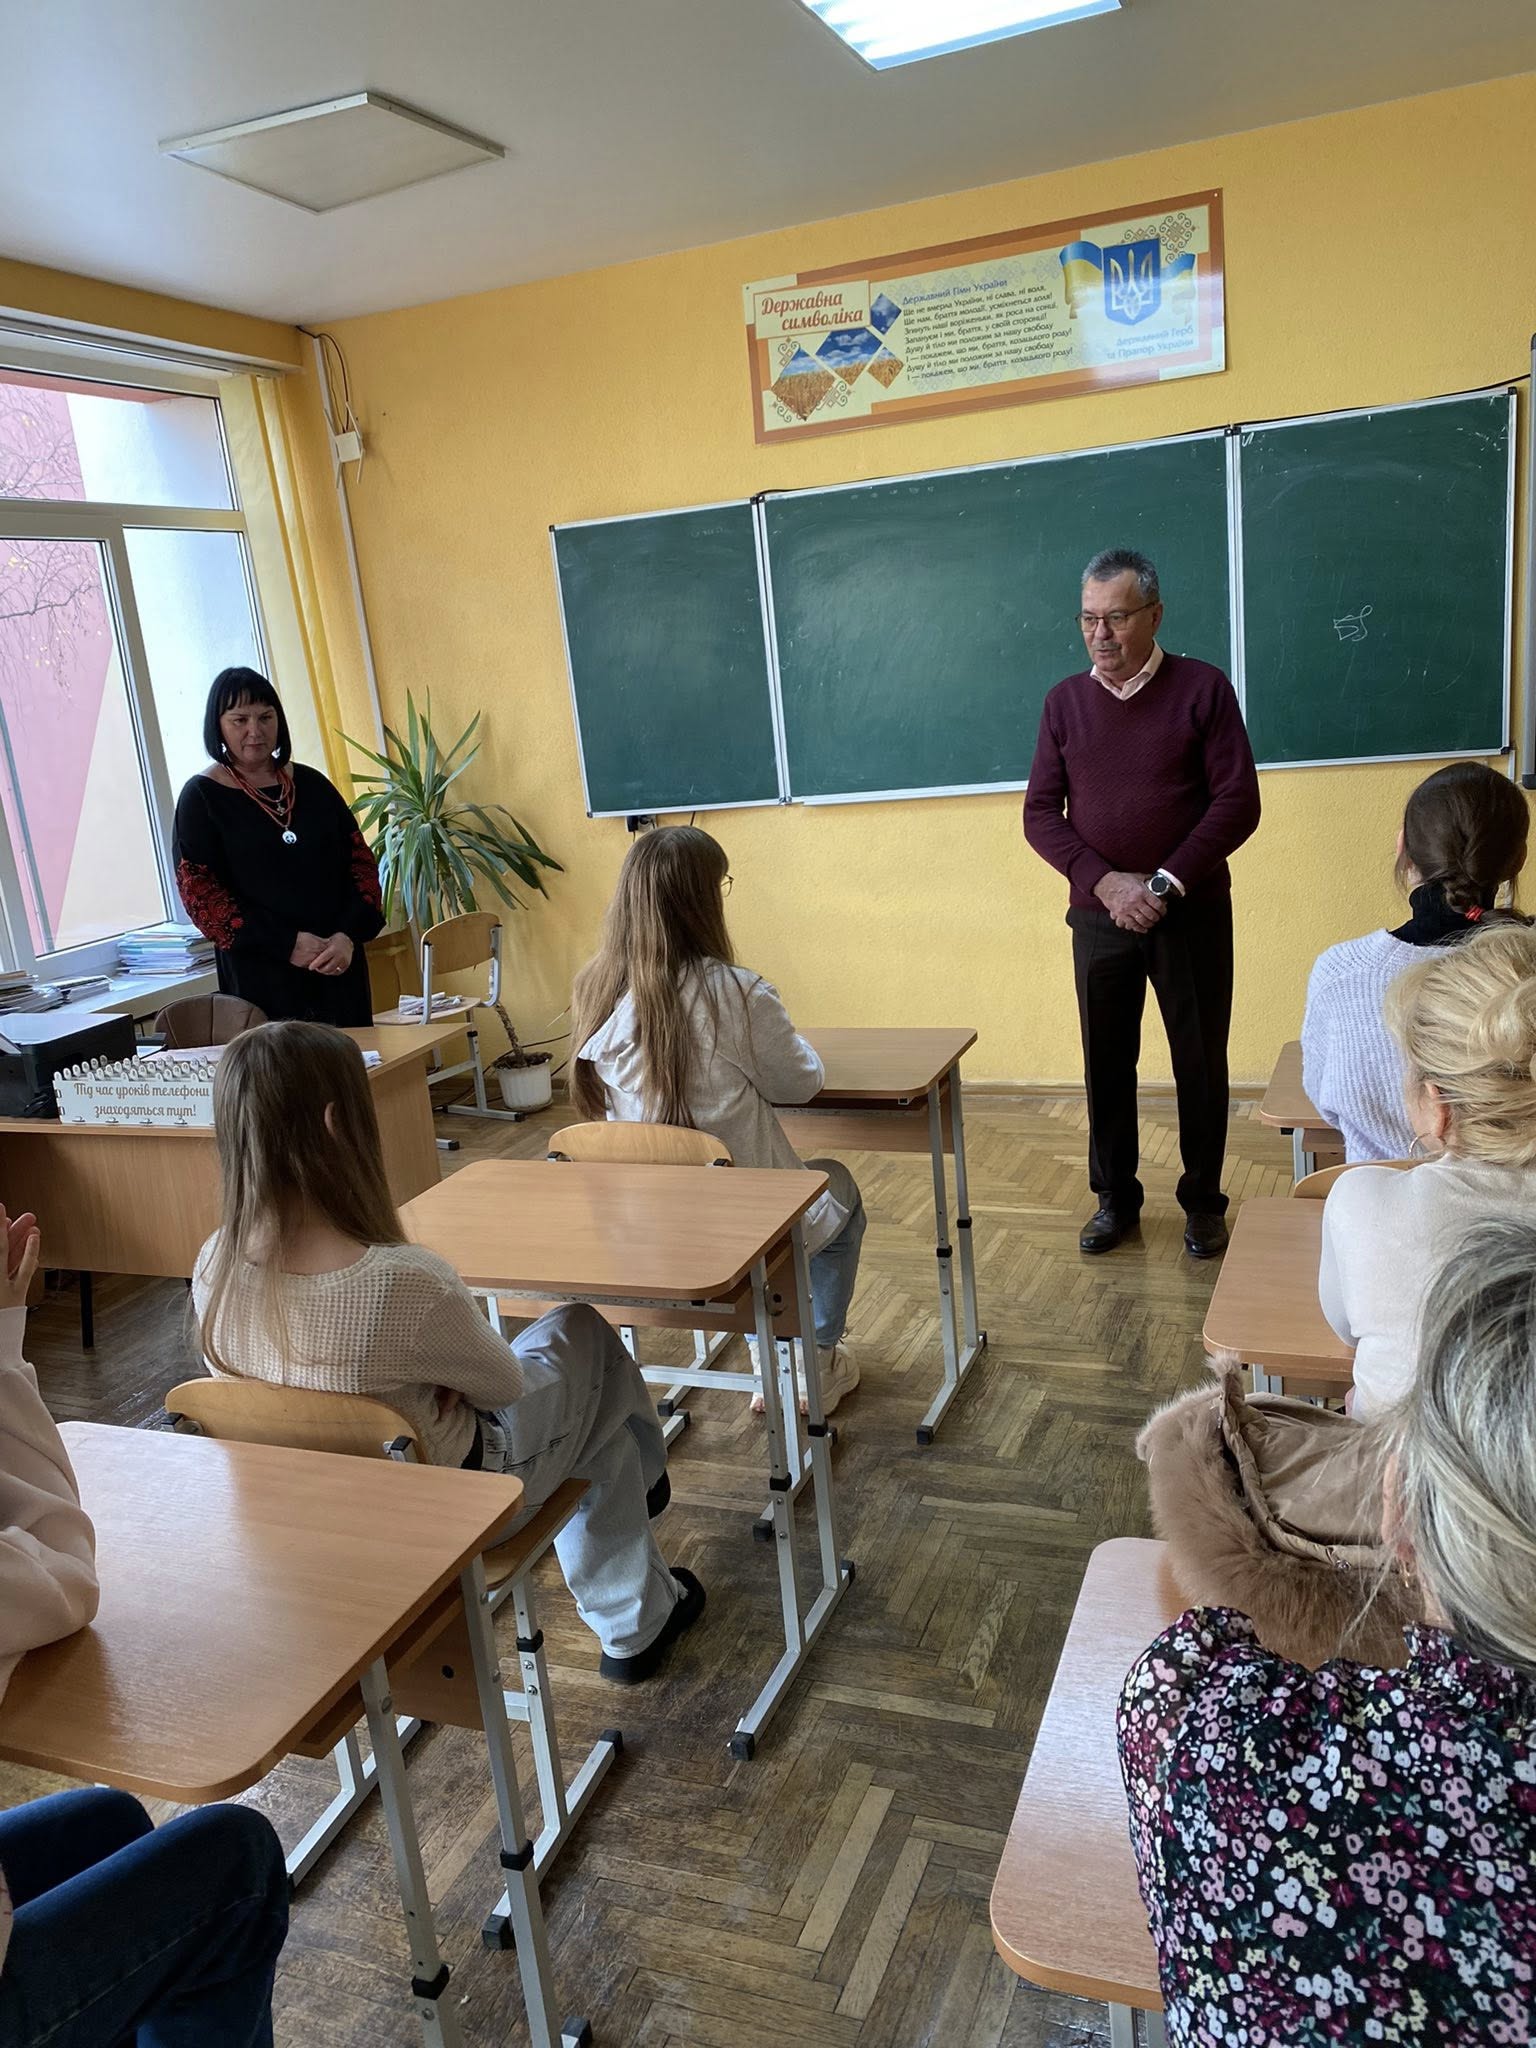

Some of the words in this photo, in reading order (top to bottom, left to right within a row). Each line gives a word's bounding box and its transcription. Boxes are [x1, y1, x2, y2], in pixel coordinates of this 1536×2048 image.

[902, 288, 951, 305] Державний
[953, 286, 971, 296] Гімн
[973, 280, 1008, 292] України
[989, 297, 1032, 311] усміхнеться
[1033, 292, 1053, 303] доля!
[761, 291, 843, 318] Державна
[927, 302, 952, 313] вмерла
[781, 308, 863, 331] символіка
[905, 325, 931, 335] Згинуть
[932, 321, 948, 330] наші
[1005, 308, 1023, 318] роса
[905, 333, 938, 345] Запануєм
[992, 320, 1011, 330] своїй
[1012, 312, 1047, 325] сторонці!
[905, 345, 924, 354] Душу
[932, 341, 946, 349] тіло
[959, 334, 992, 344] положим
[1003, 328, 1022, 336] нашу
[1023, 322, 1054, 334] свободу
[1010, 333, 1050, 345] козацького
[1052, 327, 1073, 339] роду!
[1171, 325, 1194, 337] Герб
[907, 364, 925, 373] Душу
[933, 359, 947, 367] тіло
[960, 352, 993, 363] положим
[1004, 347, 1023, 355] нашу
[1024, 341, 1054, 352] свободу
[1010, 352, 1051, 364] козацького
[1052, 347, 1073, 359] роду!
[1118, 346, 1155, 358] Прапор
[1156, 339, 1194, 352] України
[73, 1083, 94, 1098] Під
[95, 1086, 114, 1096] час
[115, 1083, 150, 1099] уроків
[152, 1084, 209, 1100] телефони
[94, 1105, 165, 1119] знаходяться
[167, 1104, 197, 1118] тут!
